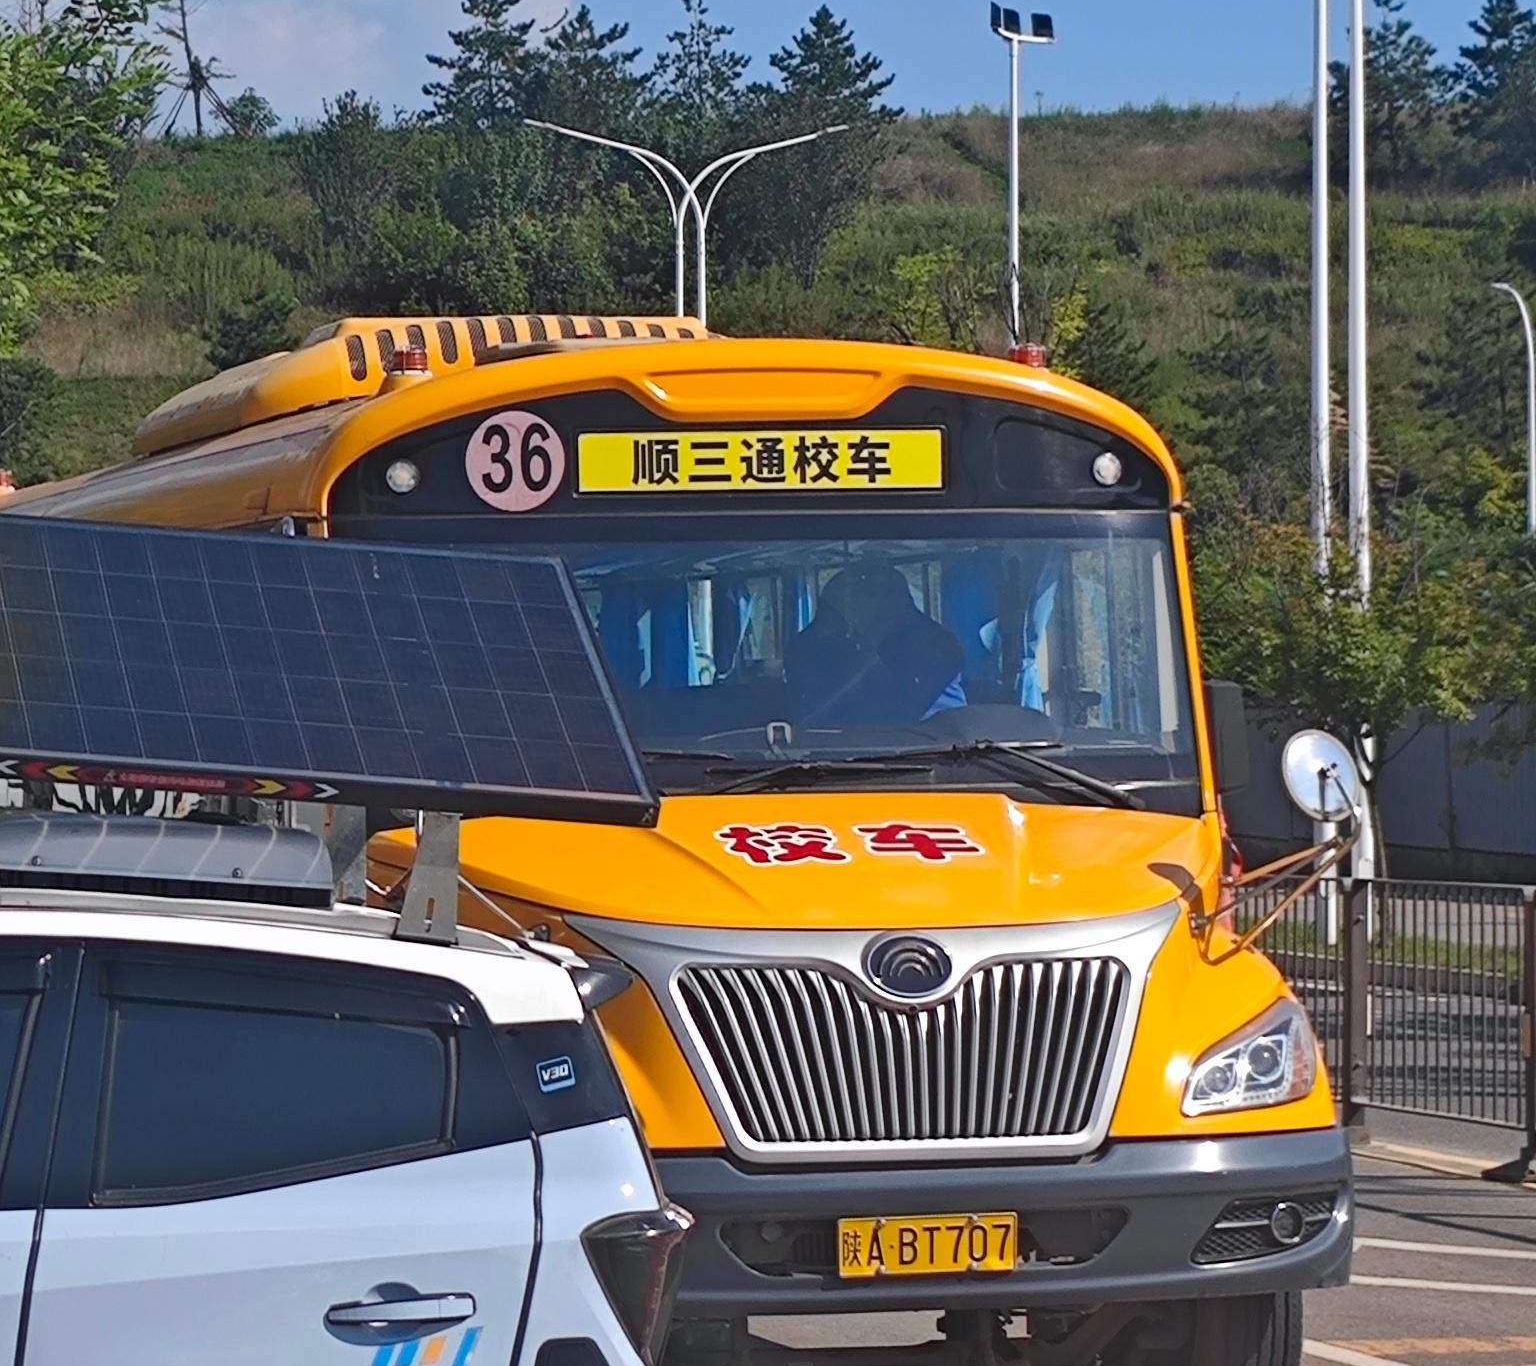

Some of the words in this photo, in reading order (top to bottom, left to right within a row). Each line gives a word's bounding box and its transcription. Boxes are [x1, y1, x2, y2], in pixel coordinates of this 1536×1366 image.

[481, 424, 553, 493] 36
[631, 435, 891, 485] 顺三通校车
[714, 821, 986, 865] 校车
